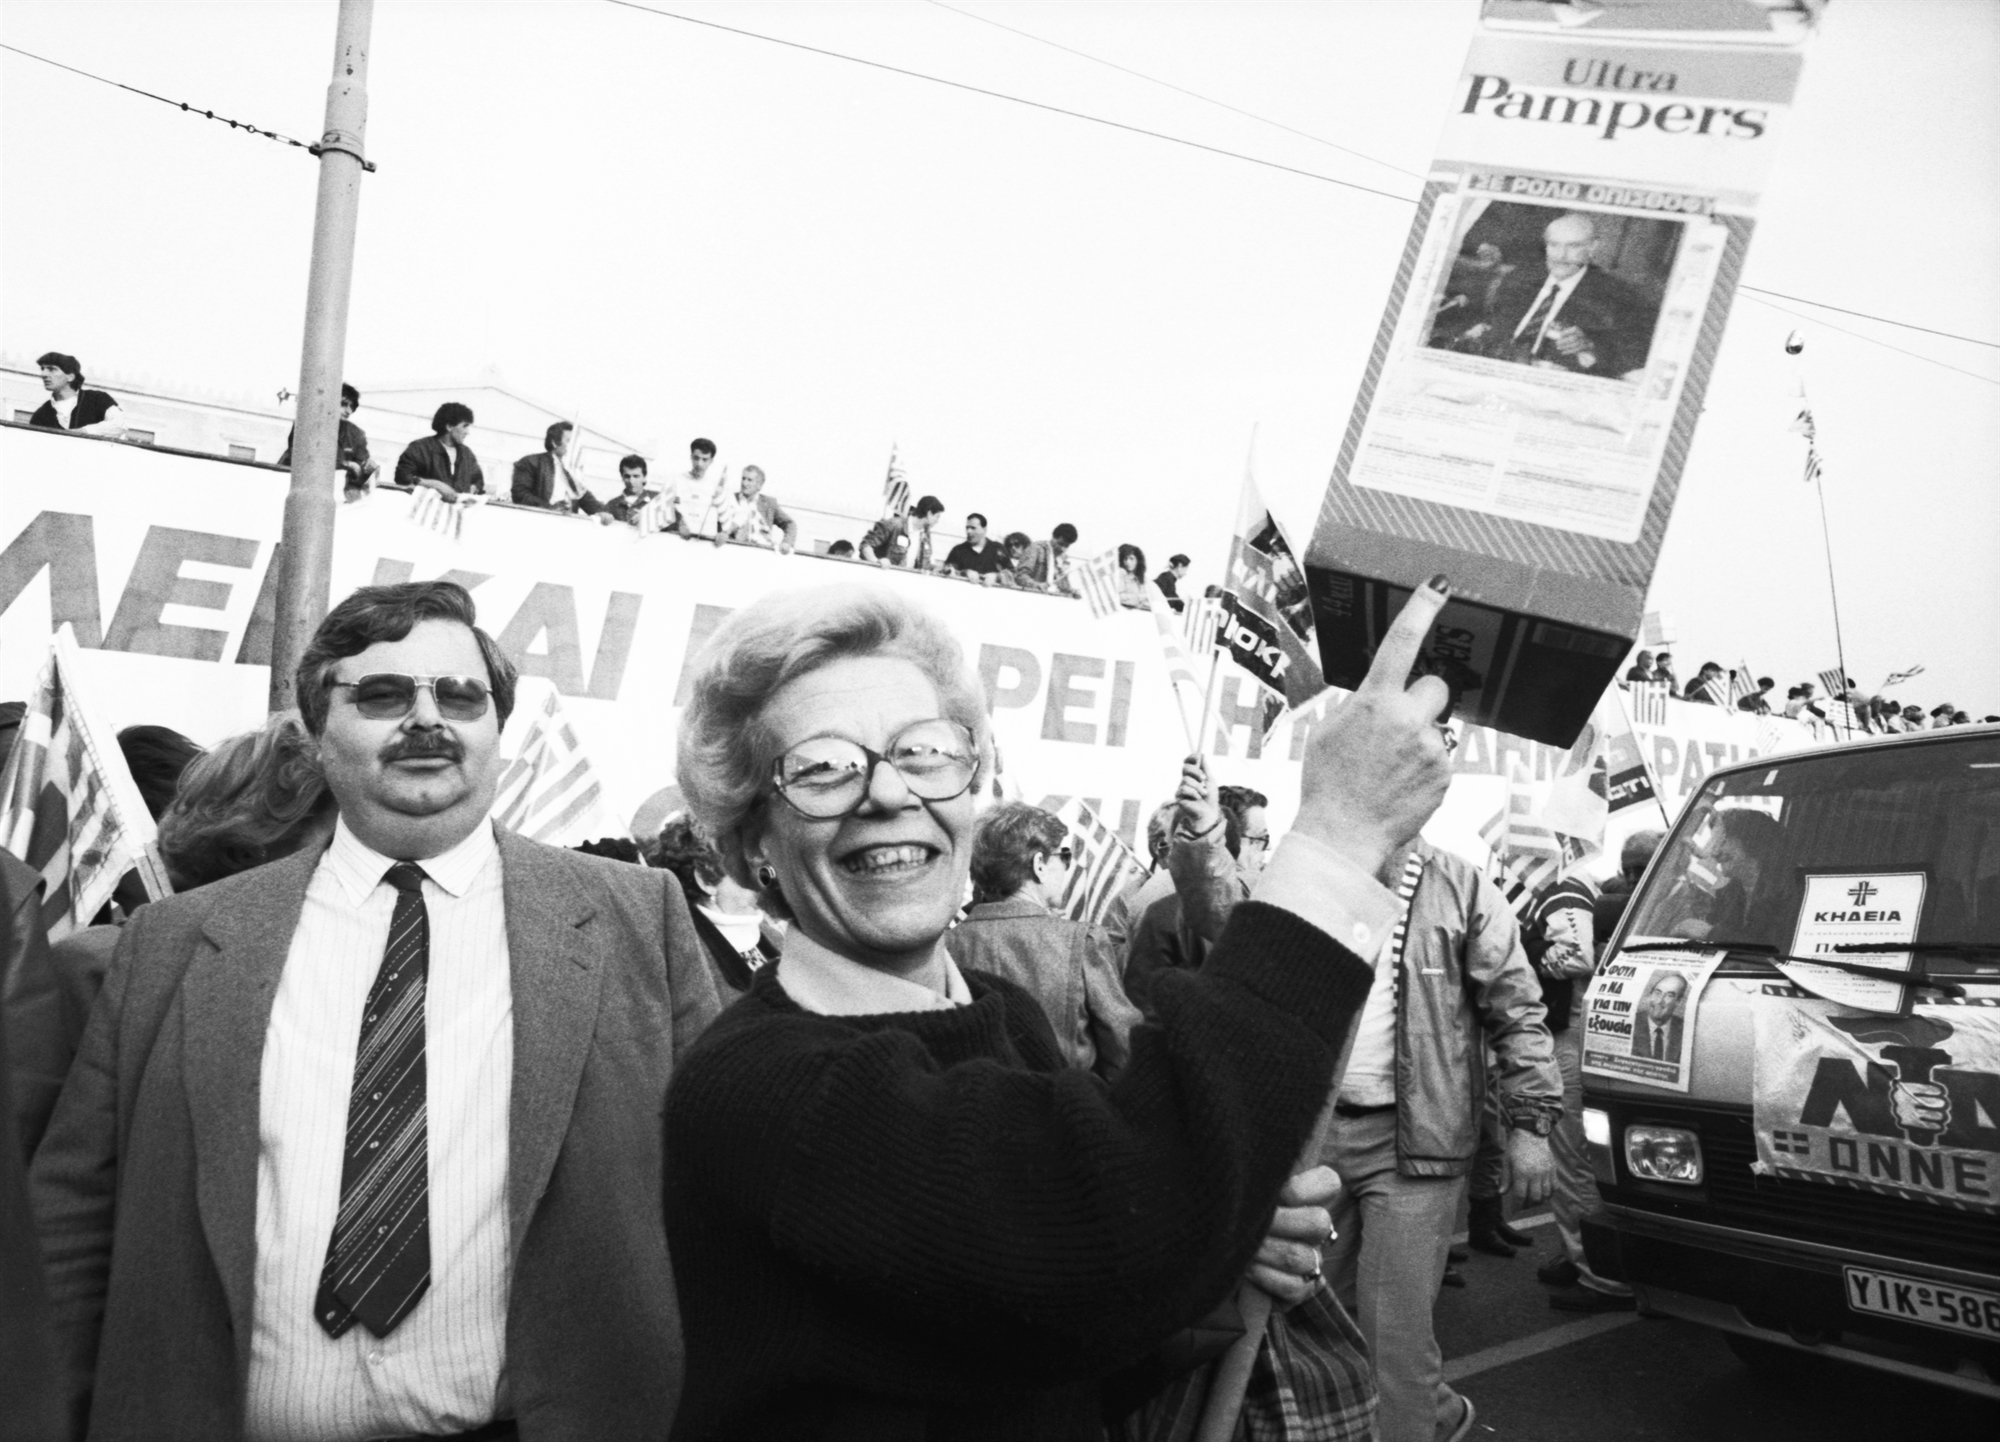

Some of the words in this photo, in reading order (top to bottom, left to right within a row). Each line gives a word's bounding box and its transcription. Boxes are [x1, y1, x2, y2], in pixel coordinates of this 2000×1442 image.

[1563, 58, 1679, 91] Ultra
[1458, 73, 1769, 140] Pampers
[1511, 176, 1581, 199] ΡΟΛΟ
[1814, 911, 1902, 922] ΚΗΔΕΙΑ
[1593, 998, 1610, 1010] για
[1612, 1001, 1632, 1013] την
[1588, 1015, 1633, 1035] εξουσία
